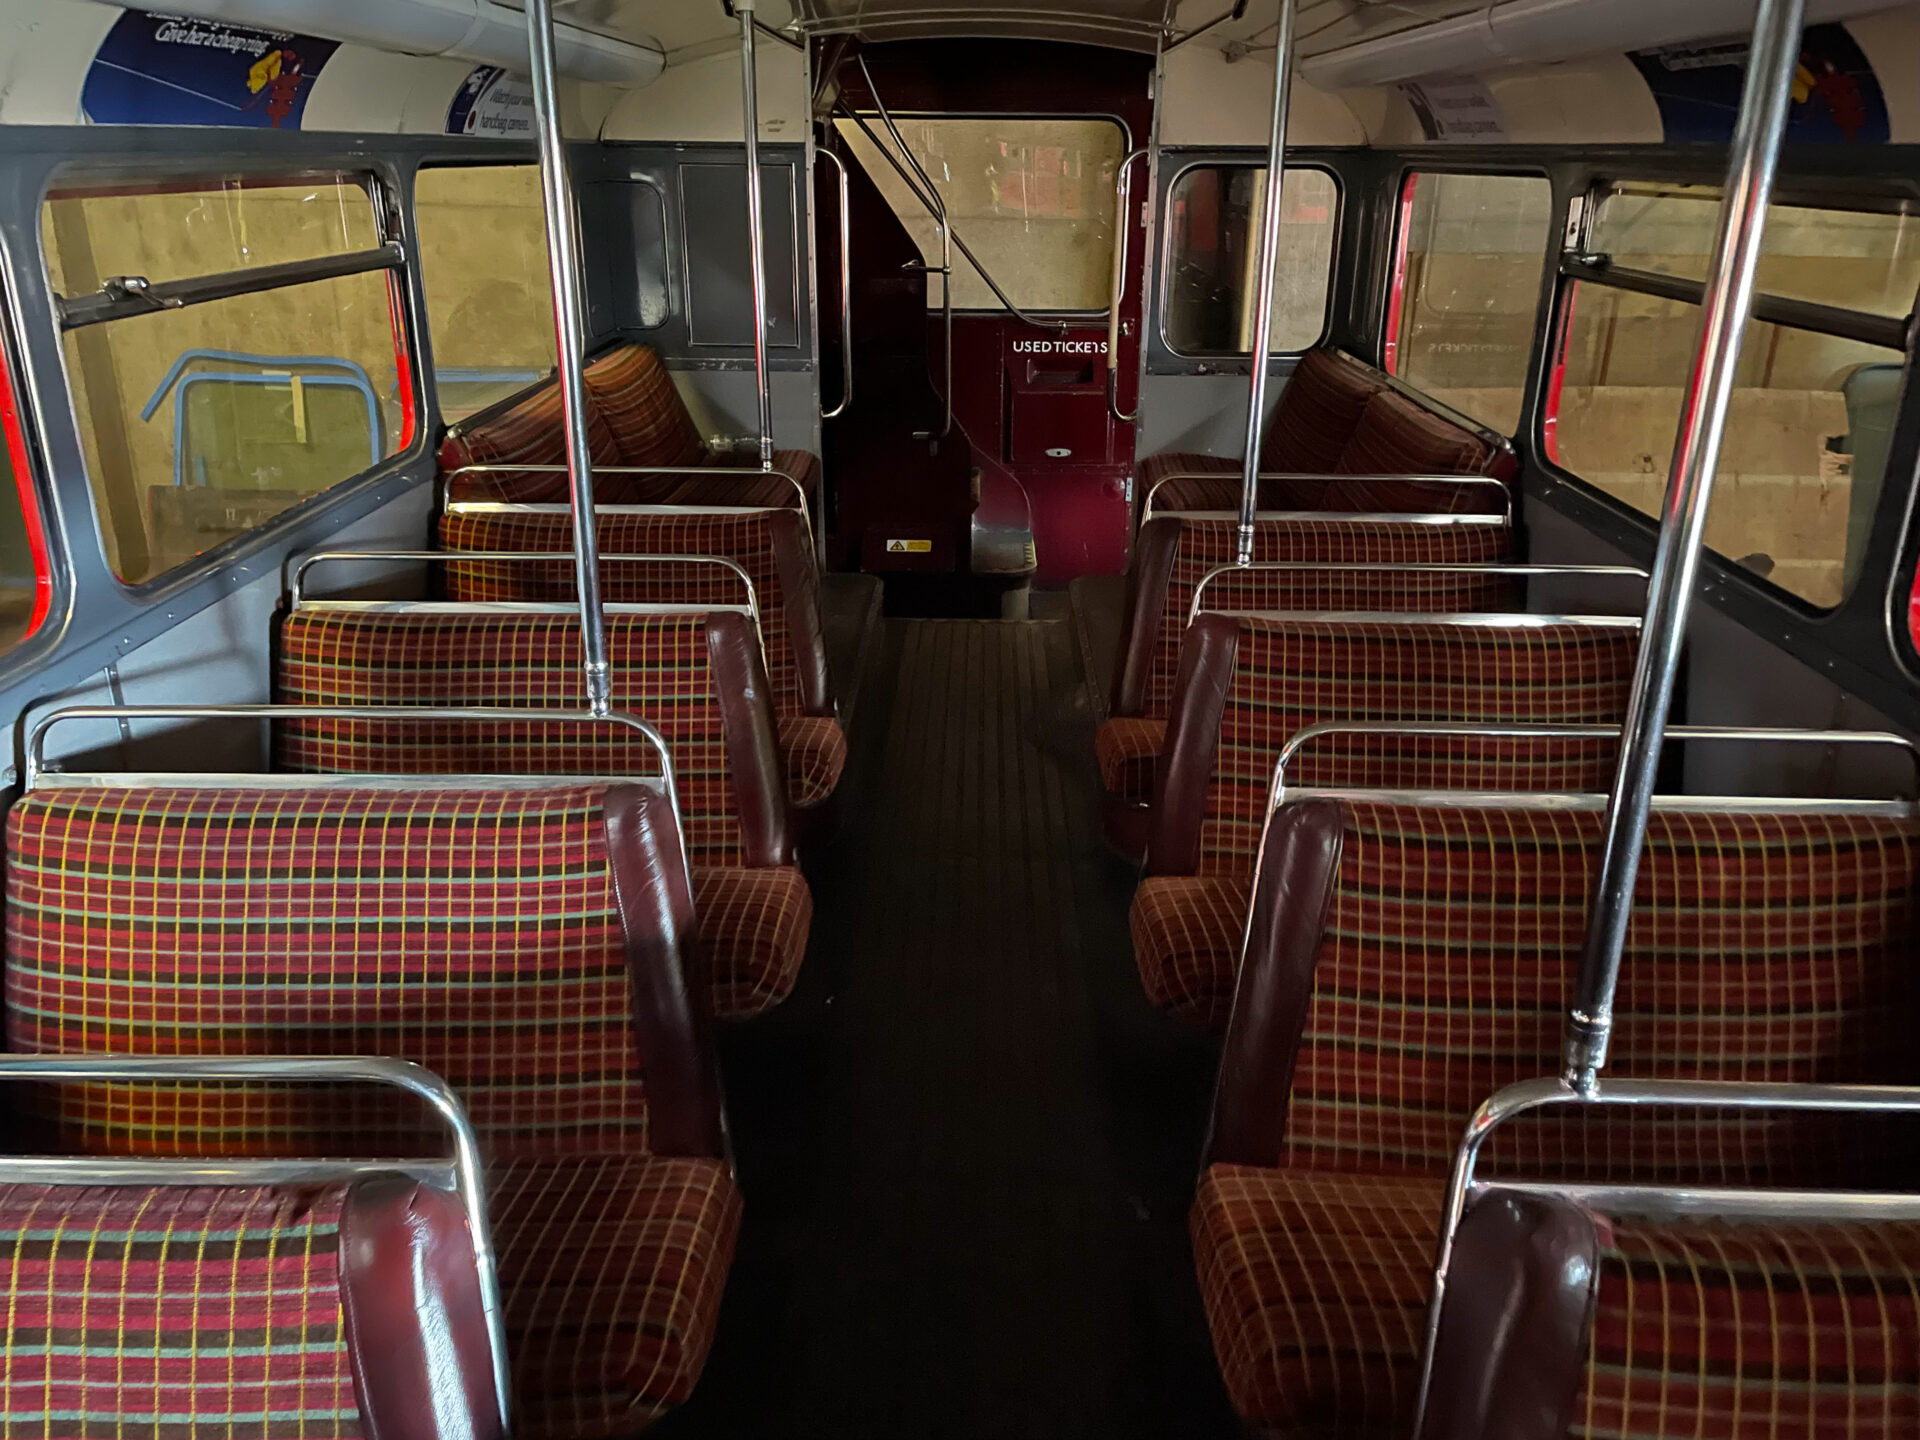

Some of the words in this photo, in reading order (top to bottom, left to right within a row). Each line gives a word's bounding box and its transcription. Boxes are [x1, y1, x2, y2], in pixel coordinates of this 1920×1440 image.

[155, 21, 187, 43] Give
[184, 25, 206, 46] her
[213, 30, 246, 54] cheap
[1012, 341, 1052, 353] USED
[1053, 341, 1108, 354] TICKETS
